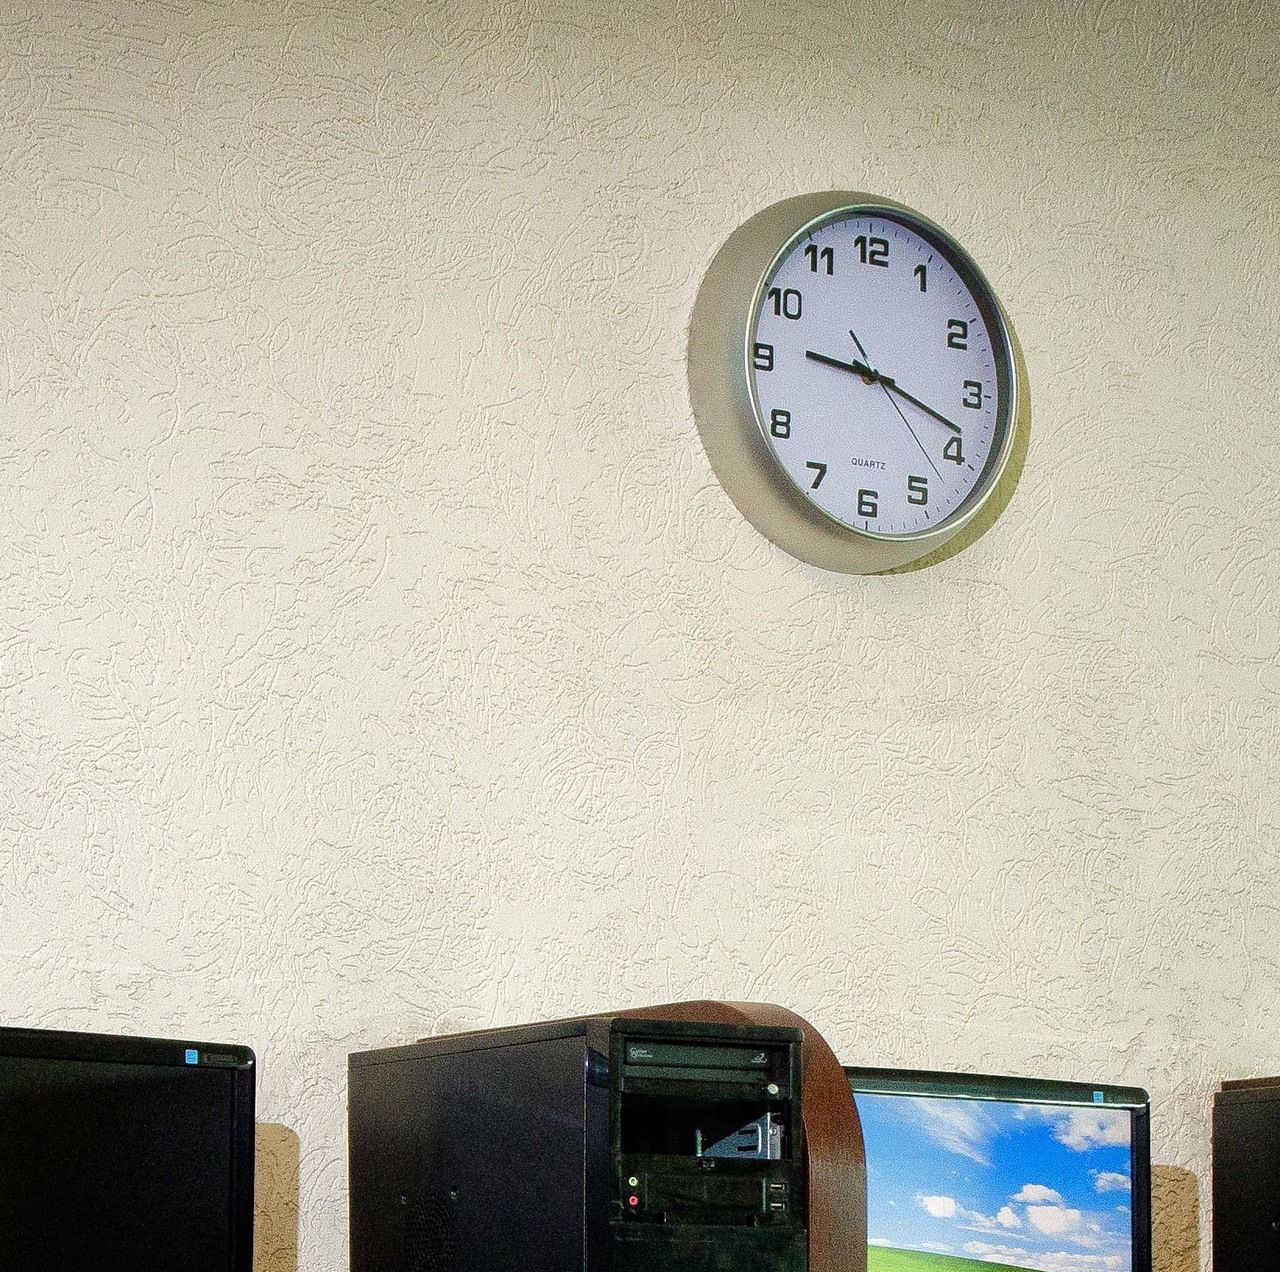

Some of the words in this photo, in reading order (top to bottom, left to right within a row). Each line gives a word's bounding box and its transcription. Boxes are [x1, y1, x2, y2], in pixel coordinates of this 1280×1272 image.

[804, 244, 834, 276] 11
[853, 235, 889, 268] 12
[914, 264, 928, 292] 1
[767, 286, 802, 320] 10
[947, 319, 968, 351] 2
[753, 342, 774, 371] 9
[963, 380, 982, 410] 3
[769, 409, 791, 439] 8
[851, 457, 886, 470] QUARTZ
[943, 436, 966, 466] 4
[805, 460, 827, 490] 7
[907, 474, 928, 505] 5
[857, 488, 879, 518] 6
